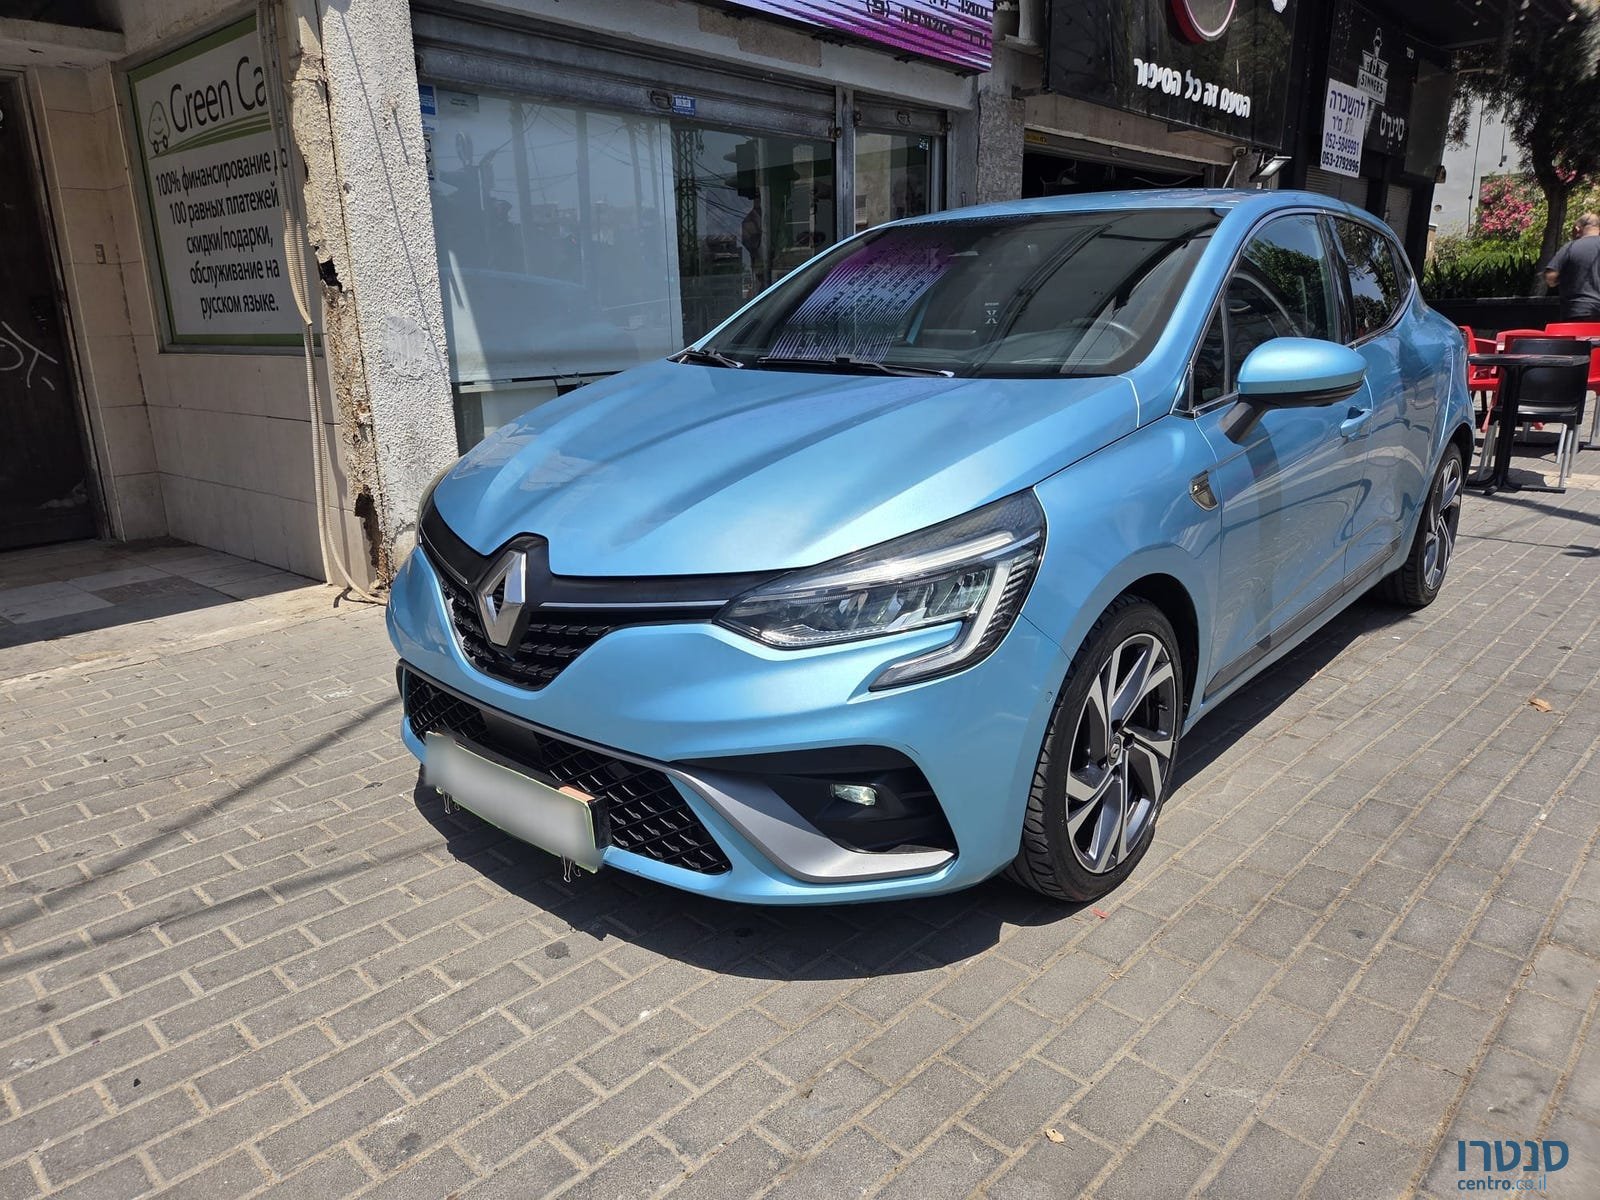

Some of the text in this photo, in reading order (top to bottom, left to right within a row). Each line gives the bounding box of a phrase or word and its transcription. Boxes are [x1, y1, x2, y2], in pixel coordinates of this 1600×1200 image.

[170, 55, 268, 133] Green Ca
[1133, 58, 1251, 118] הטעם זה כל הסיפור
[1329, 90, 1366, 120] להשכרה
[156, 170, 181, 196] 100%
[181, 152, 271, 197] финансирование
[170, 181, 280, 228] 100 равных платежей
[186, 225, 274, 257] скидки/подарки,
[190, 259, 280, 288] обслуживание на
[200, 293, 279, 320] русском языке.
